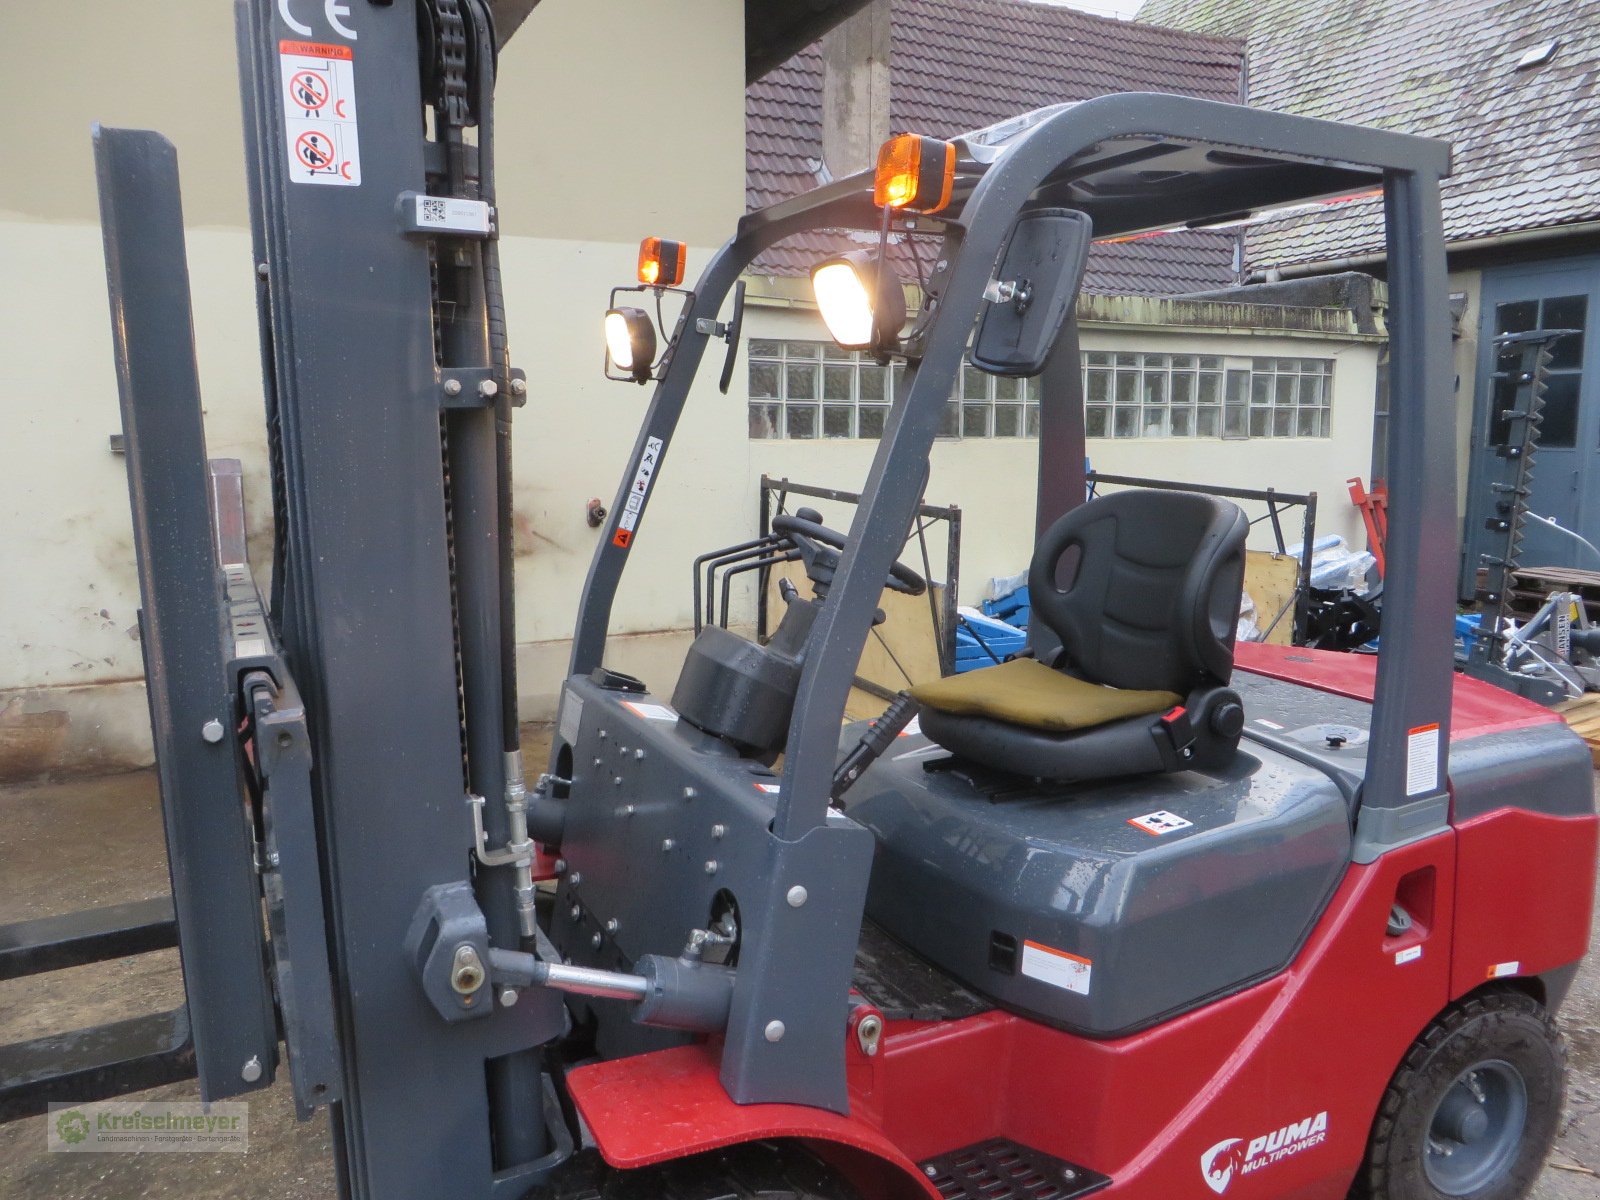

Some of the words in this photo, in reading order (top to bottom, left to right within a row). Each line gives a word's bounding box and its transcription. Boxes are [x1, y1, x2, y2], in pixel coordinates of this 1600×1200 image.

[300, 46, 344, 56] WARNING
[1241, 1132, 1326, 1175] MULTIPOWER
[1245, 1111, 1328, 1162] PUMA
